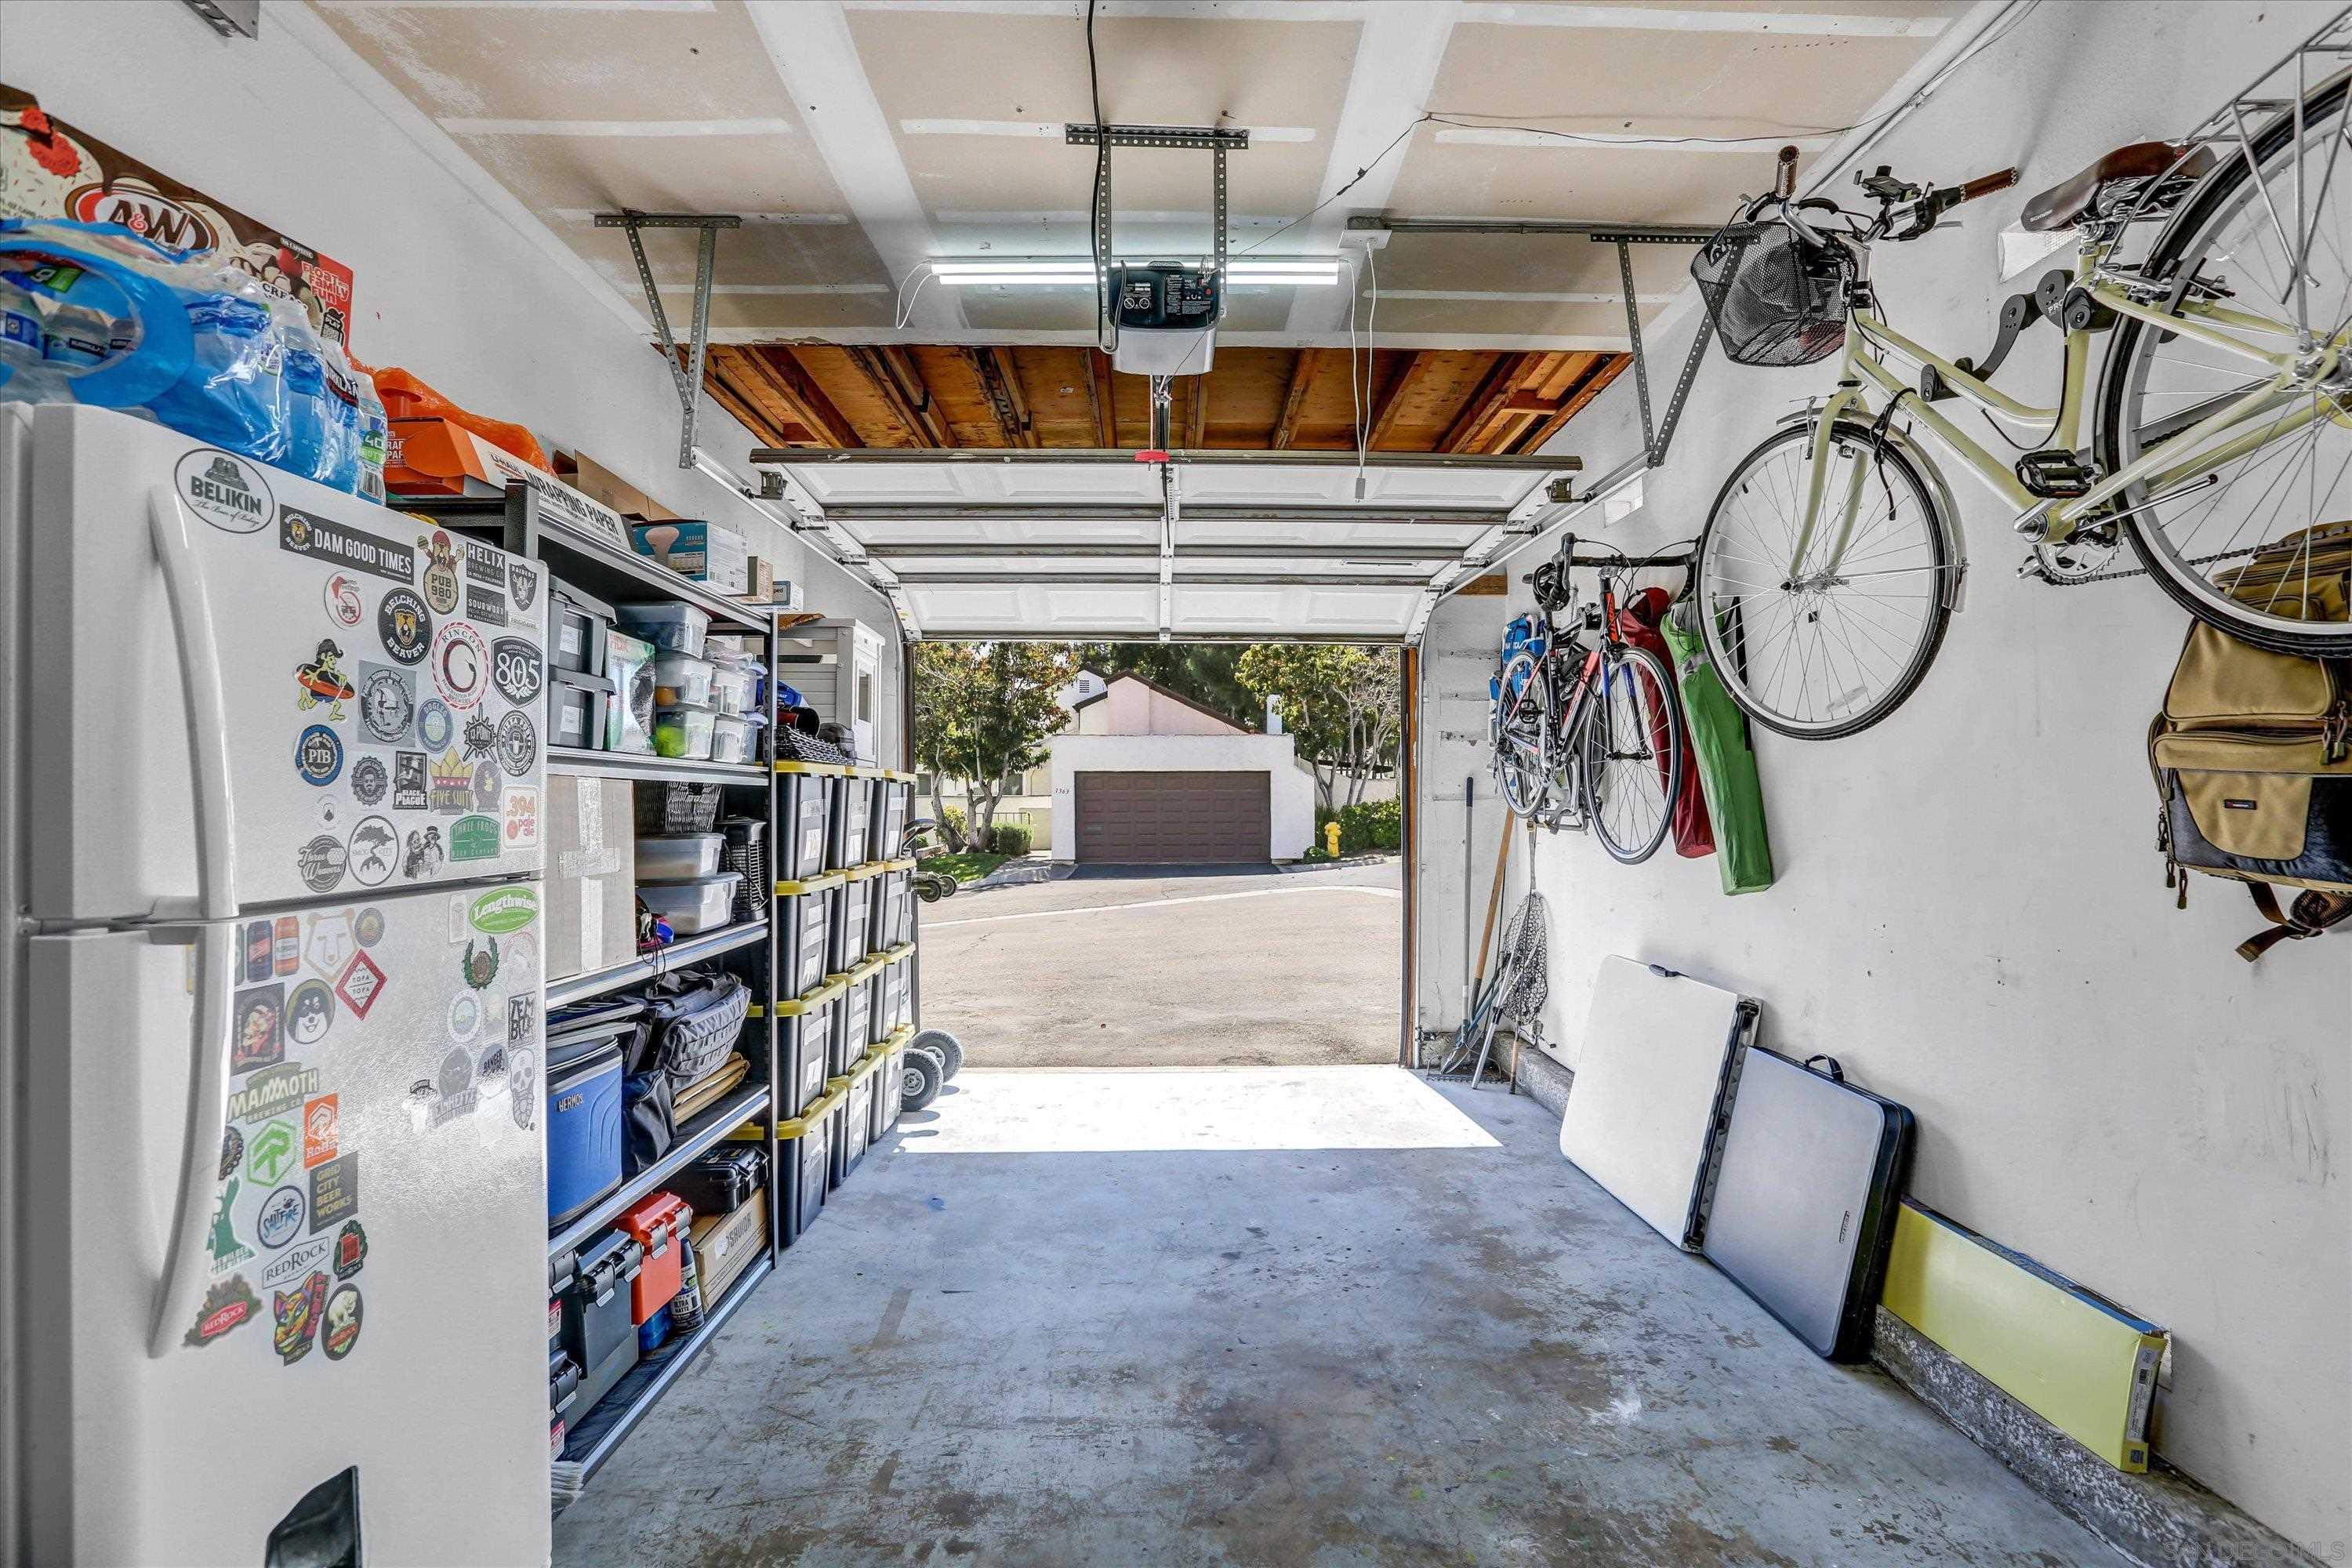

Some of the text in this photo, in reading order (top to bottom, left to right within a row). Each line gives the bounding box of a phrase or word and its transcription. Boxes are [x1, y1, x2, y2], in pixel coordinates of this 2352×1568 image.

[109, 199, 191, 247] A&W
[191, 475, 262, 516] BELIKIN
[524, 470, 586, 512] WRAPPING
[586, 500, 619, 535] PAPER
[314, 528, 343, 555] DAM
[345, 538, 376, 565] GOOD
[378, 548, 412, 575] TIMES
[468, 543, 504, 570] HELIX
[431, 574, 452, 588] PUB
[510, 564, 535, 579] RAIDERS
[431, 586, 452, 600] 980
[384, 594, 426, 622] BELCHING
[468, 598, 504, 616] SOURWORX
[387, 637, 425, 659] BEAVER
[441, 629, 481, 652] RINCON
[495, 652, 540, 690] 805
[307, 749, 332, 764] PIB
[395, 792, 426, 806] PLAGUE
[432, 789, 450, 805] FIVE
[455, 822, 474, 837] THREE
[518, 816, 535, 829] pale
[523, 827, 535, 837] ale
[229, 1069, 318, 1119] MAMMOTH
[558, 1093, 583, 1112] HERMOS
[317, 1176, 340, 1194] CITY
[316, 1188, 341, 1207] BEER
[316, 1194, 352, 1218] WORKS
[266, 1242, 326, 1281] REDROCK
